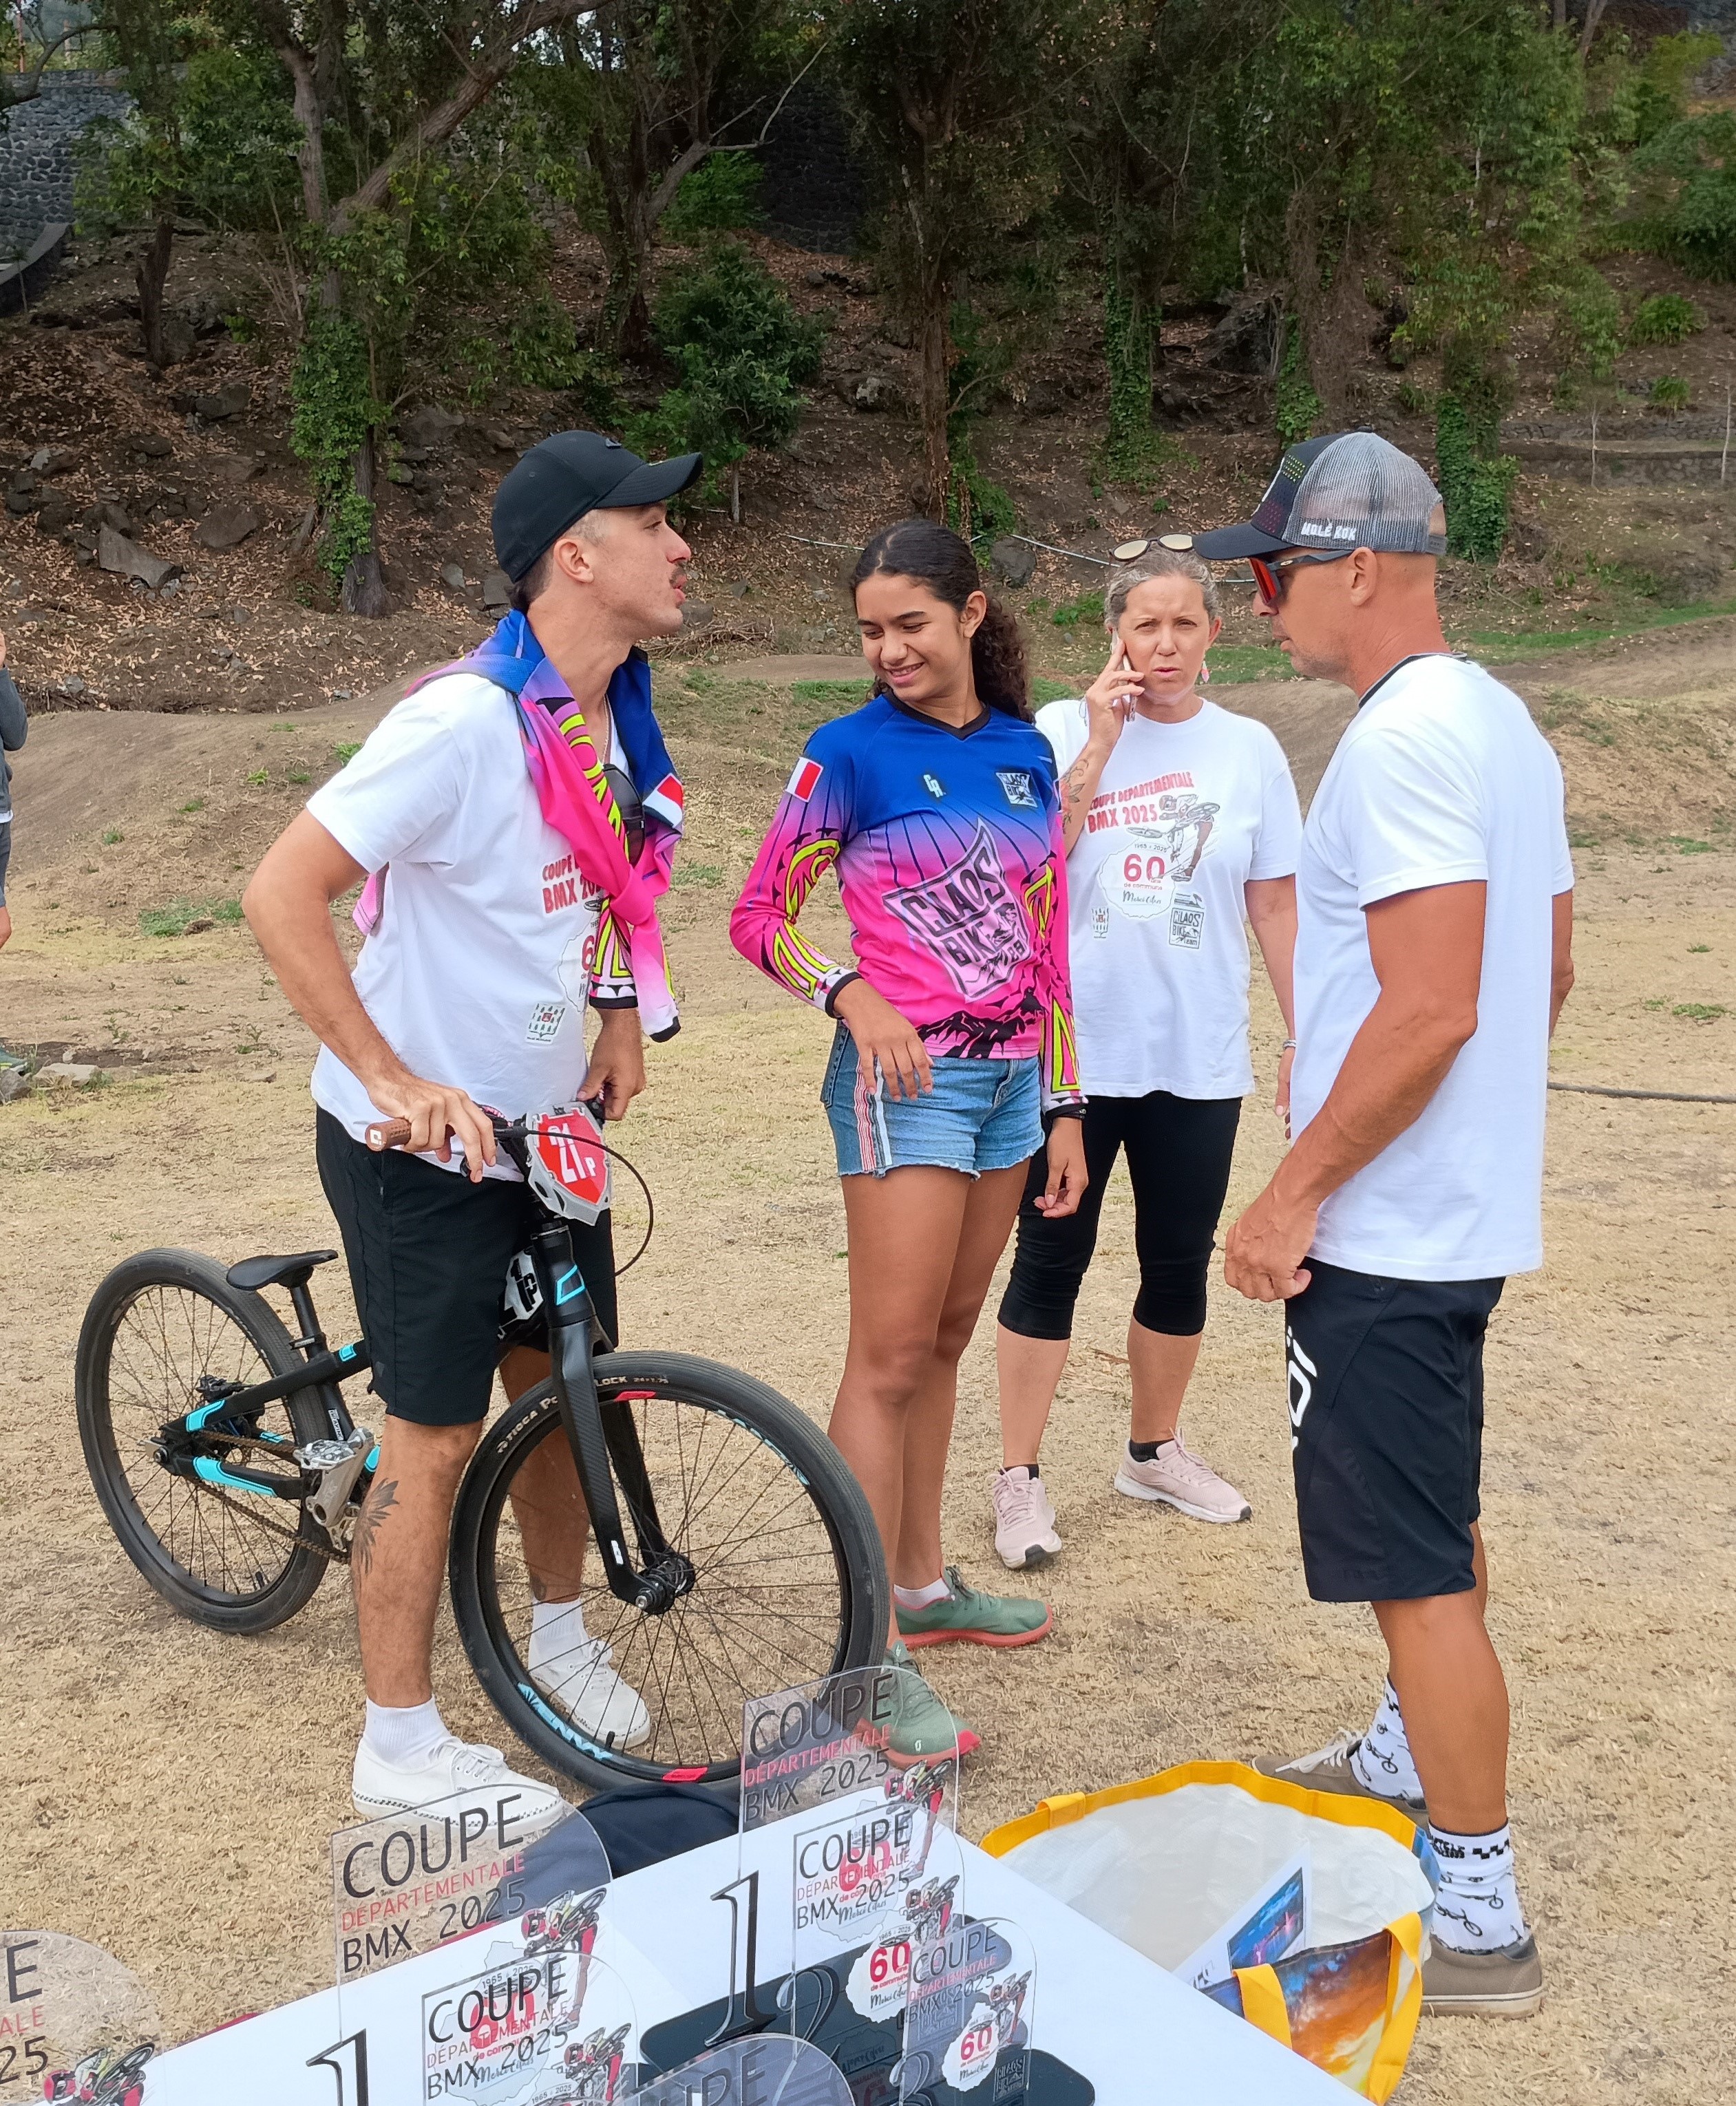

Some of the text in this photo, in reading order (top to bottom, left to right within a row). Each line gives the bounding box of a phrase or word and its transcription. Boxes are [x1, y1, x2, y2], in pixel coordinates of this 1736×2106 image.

[1119, 772, 1194, 802] DEPARTEMENTALE
[1087, 803, 1158, 833] BMX 2025
[542, 853, 572, 882] COUPE
[542, 878, 578, 914] BMX
[1123, 853, 1165, 882] 60
[750, 1673, 893, 1758] COUPE
[744, 1723, 891, 1788] DÉPARTEMENTALE
[744, 1747, 890, 1823] BMX 2025
[343, 1793, 524, 1898] COUPE
[799, 1809, 911, 1879] COUPE
[341, 1851, 525, 1933] DÉPARTEMENTALE
[797, 1853, 910, 1902] DÉPARTEMENTALE
[797, 1893, 839, 1929] BMX
[855, 1868, 910, 1908] 2025
[343, 1878, 526, 1973] BMX 2025
[913, 1922, 998, 1983] COUPE
[482, 1972, 502, 1988] 1965
[705, 1870, 776, 2048] 1
[869, 1941, 911, 1983] 60
[953, 1969, 995, 2003] 2025
[428, 1956, 567, 2043] COUPE
[427, 2001, 569, 2069] DÉPARTEMENTALE
[427, 2058, 480, 2100] BMX
[501, 2026, 569, 2070] 2025
[960, 2026, 993, 2061] 60
[555, 2084, 572, 2095] 2025
